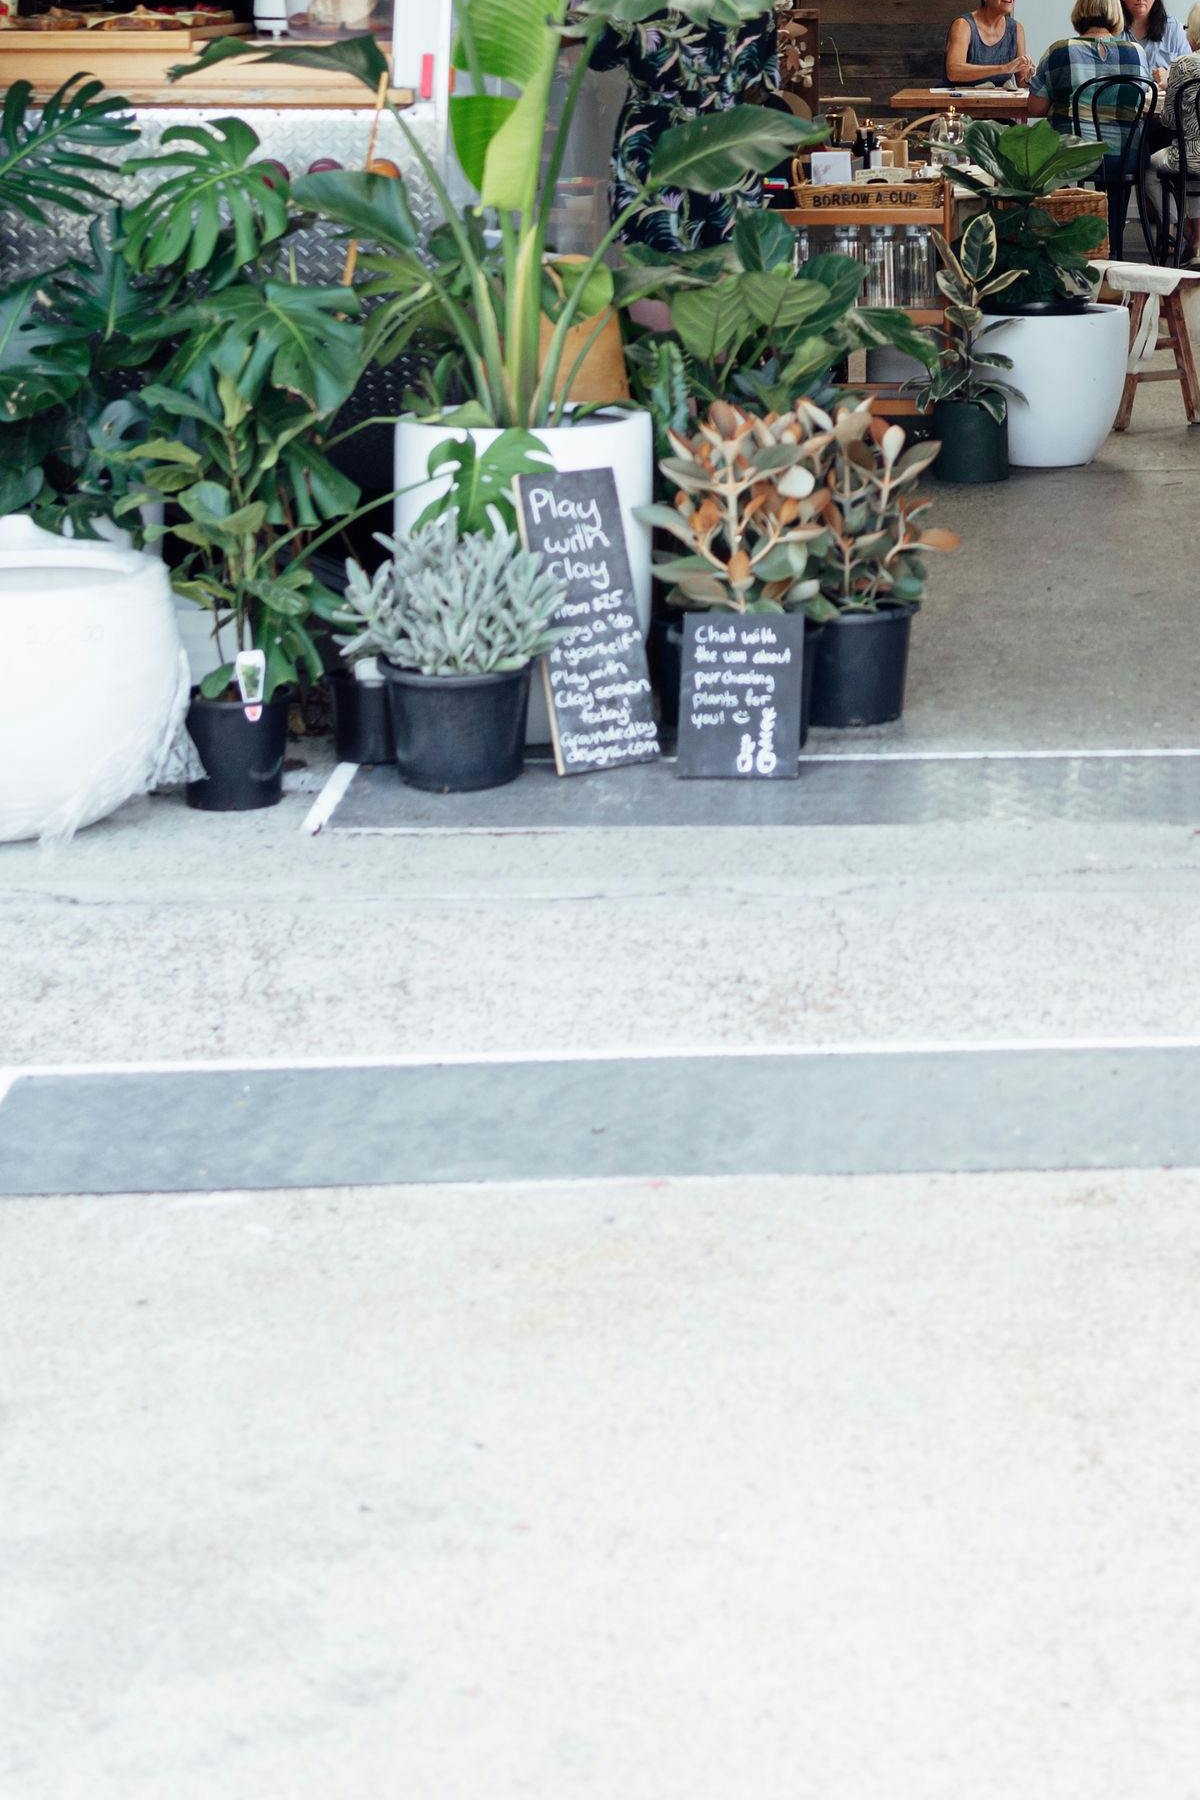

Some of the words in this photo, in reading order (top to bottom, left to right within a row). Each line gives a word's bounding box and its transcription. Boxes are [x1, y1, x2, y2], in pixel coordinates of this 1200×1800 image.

[813, 192, 870, 208] BORROW
[875, 193, 884, 203] A
[889, 192, 918, 204] CUP
[529, 487, 602, 533] Play
[543, 522, 611, 554] with
[694, 624, 737, 643] Chat
[740, 627, 777, 645] with
[694, 645, 718, 663] the
[722, 650, 747, 663] van
[752, 647, 791, 664] about
[550, 669, 590, 691] Play
[588, 658, 629, 681] with
[694, 669, 775, 693] purchasing
[554, 689, 595, 711] Clay
[692, 690, 739, 710] plants
[745, 687, 772, 706] for
[690, 710, 725, 730] you!
